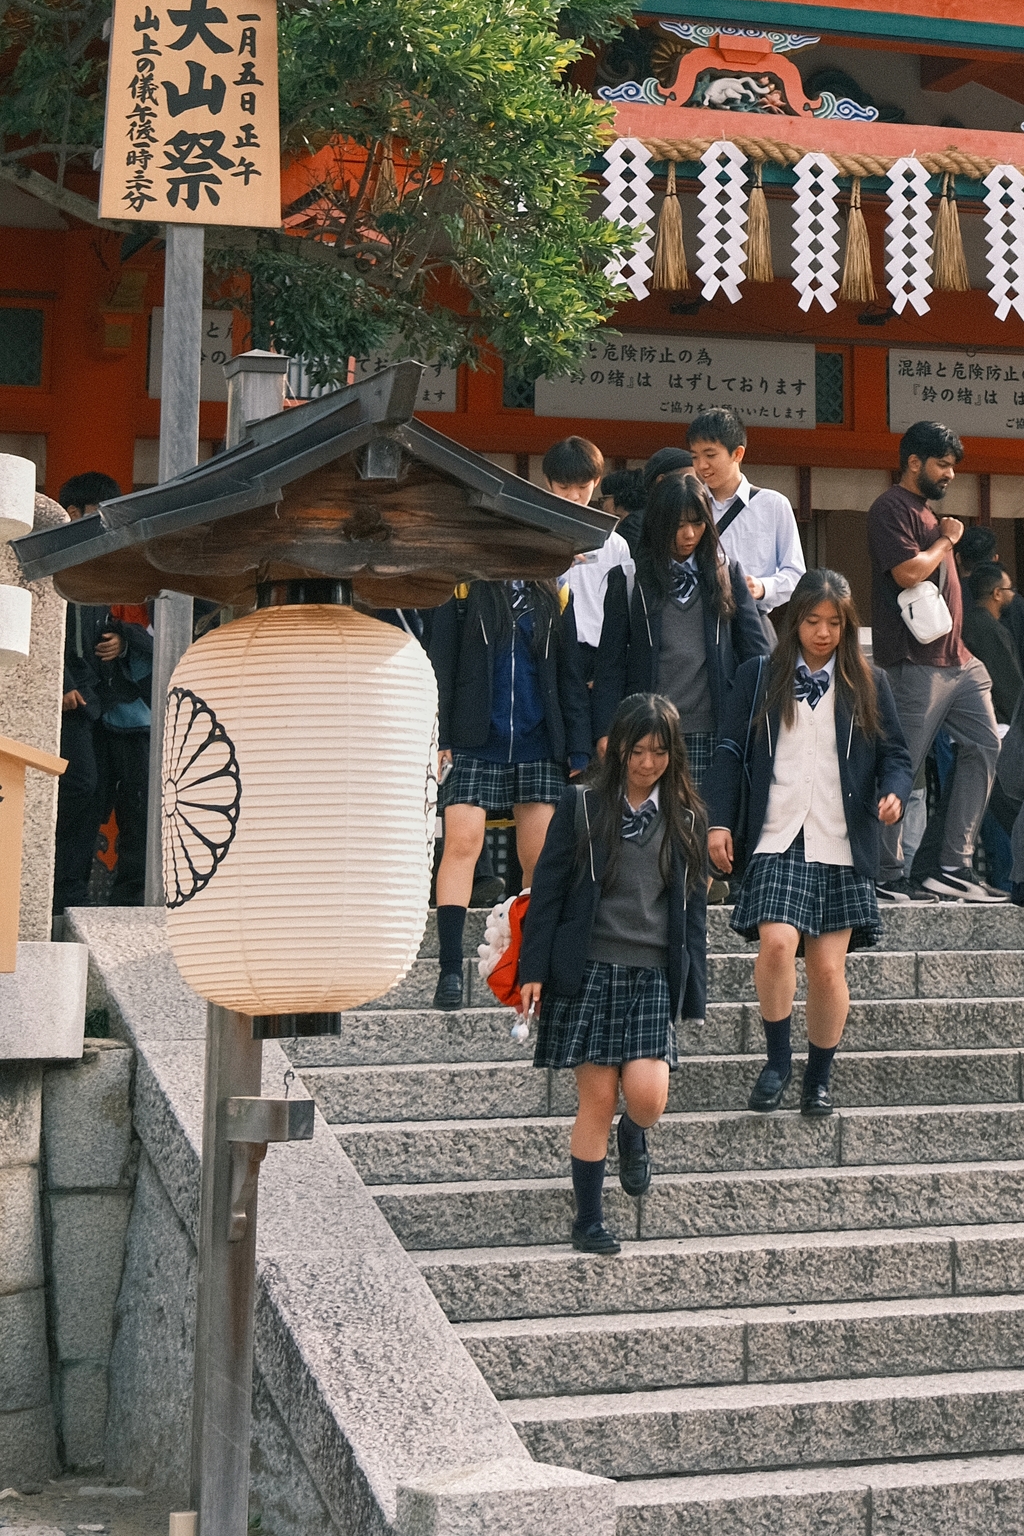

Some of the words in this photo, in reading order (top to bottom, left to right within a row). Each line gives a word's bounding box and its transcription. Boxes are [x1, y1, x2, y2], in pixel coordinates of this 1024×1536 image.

[668, 373, 806, 396] はずしております
